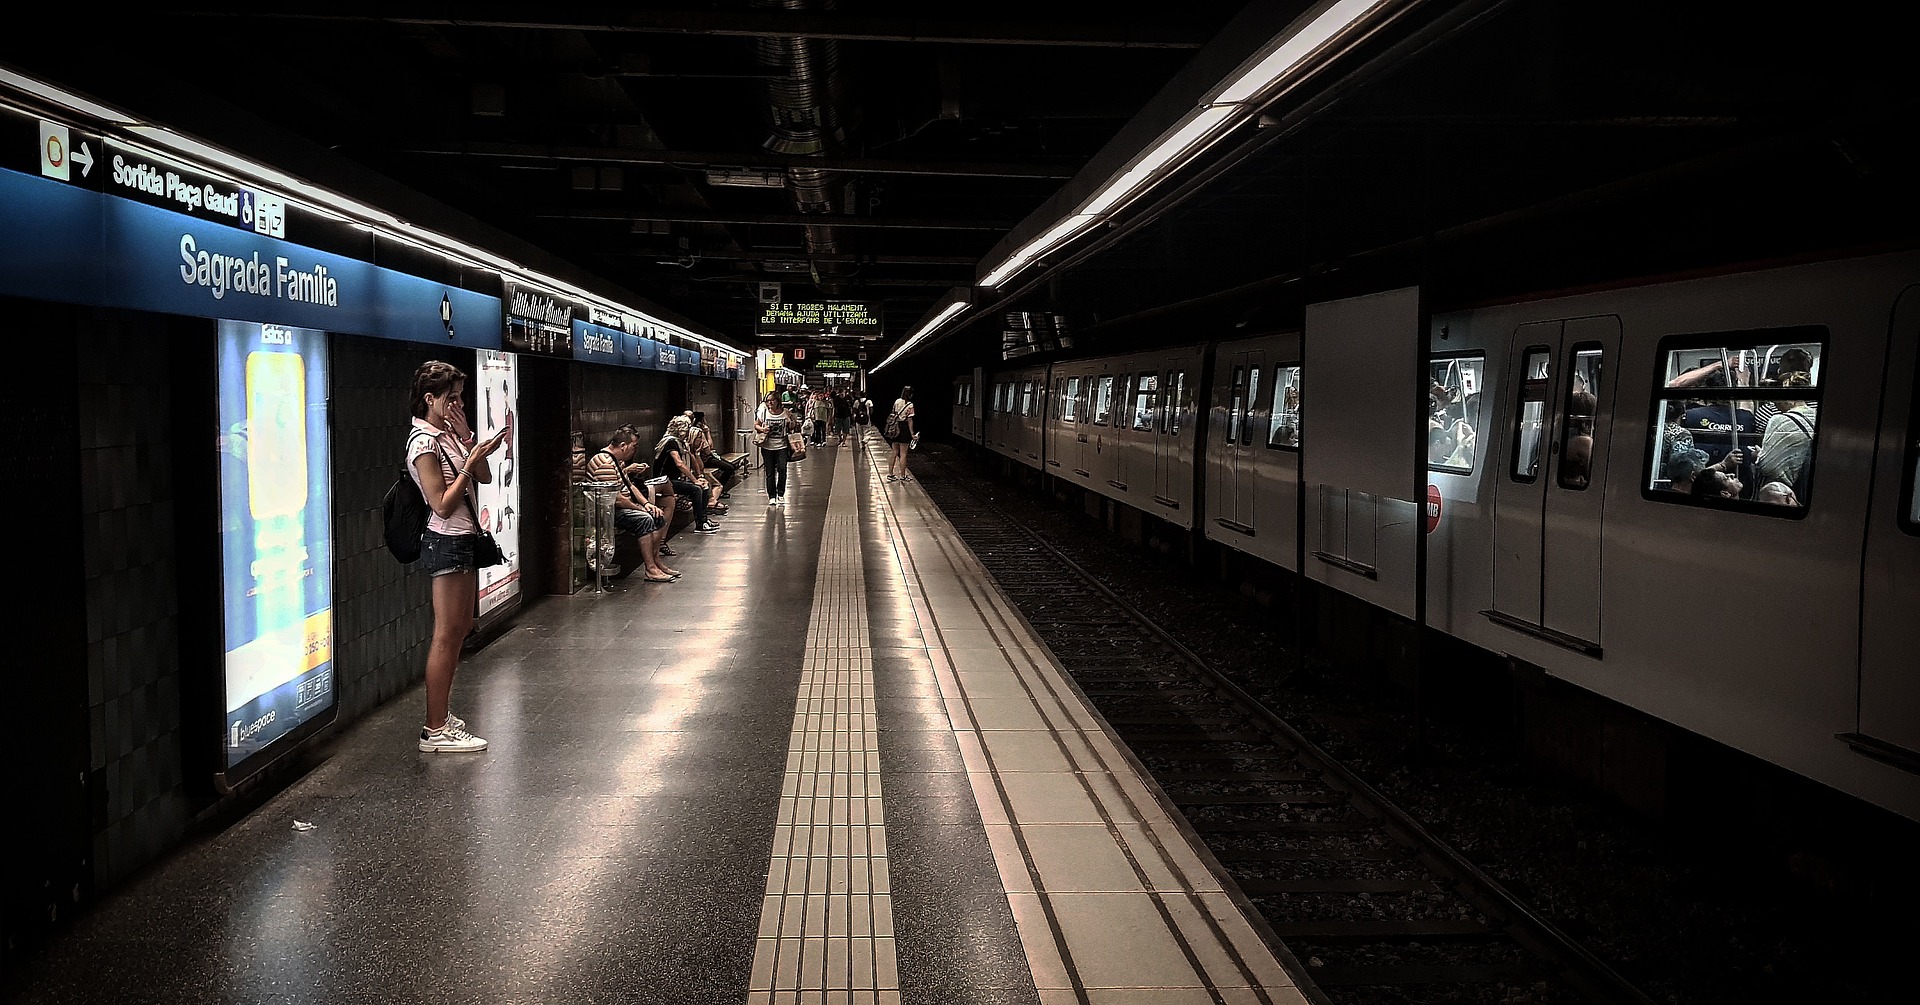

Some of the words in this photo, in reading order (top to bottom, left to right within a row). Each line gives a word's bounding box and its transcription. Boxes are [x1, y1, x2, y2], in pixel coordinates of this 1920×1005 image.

[112, 154, 164, 196] Sortida
[165, 171, 202, 212] Plaça
[203, 184, 239, 217] Gaudí
[179, 233, 271, 300] Sagrada
[276, 255, 338, 307] Família
[797, 303, 824, 311] TROBES
[823, 310, 868, 318] UTILITZANT
[761, 316, 776, 324] ELS
[1426, 502, 1439, 518] MB
[240, 710, 276, 742] bluespace
